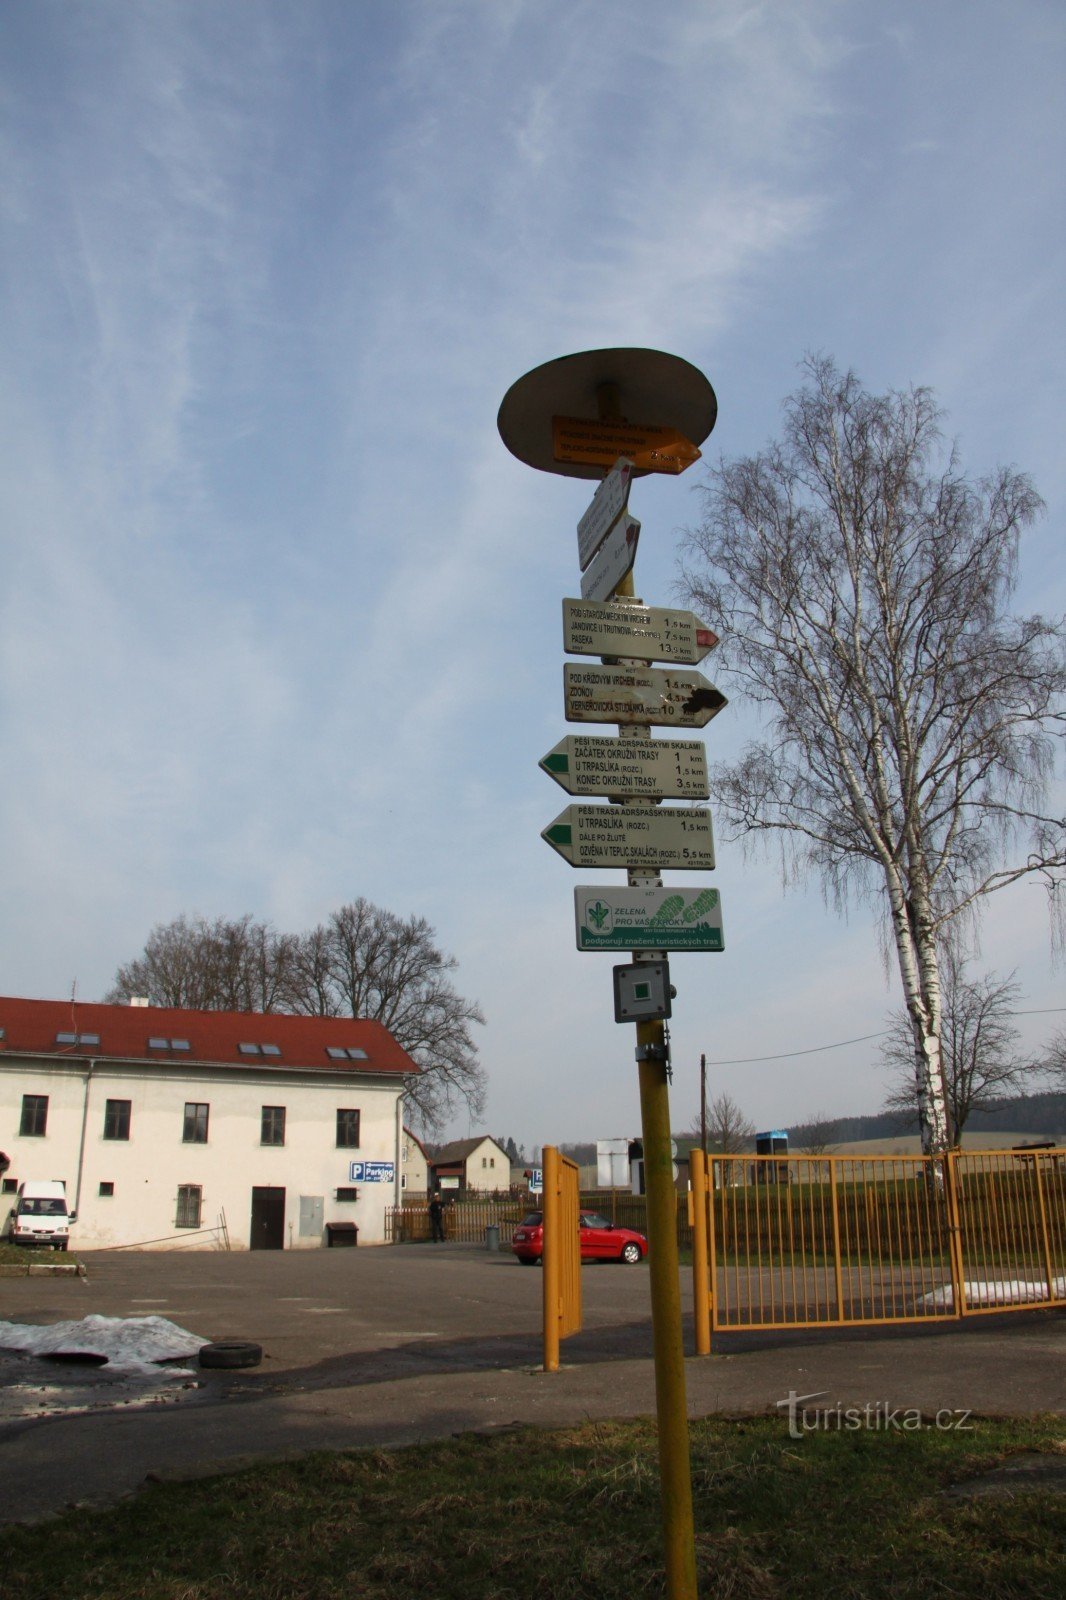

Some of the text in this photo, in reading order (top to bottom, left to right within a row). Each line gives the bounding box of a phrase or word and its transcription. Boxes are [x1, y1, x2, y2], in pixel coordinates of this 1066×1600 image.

[570, 608, 582, 617] POD
[680, 622, 691, 630] km
[570, 622, 598, 632] JANOVICE
[598, 624, 602, 632] U
[603, 624, 632, 636] TRUTNOVA
[665, 630, 678, 640] 7,5
[680, 634, 691, 642] km
[572, 634, 593, 644] PASEKA
[679, 646, 692, 654] km
[570, 674, 582, 683] POD
[612, 676, 636, 686] VRCHEM
[614, 700, 644, 715] STUDÁNKA
[591, 739, 614, 747] TRASA
[618, 740, 670, 749] ADRŠPAŠSKÝMI
[671, 742, 700, 750] SKALAMI
[574, 748, 606, 758] ZAČÁTEK
[607, 748, 636, 760] OKRUŽNÍ
[637, 750, 659, 760] TRASY
[675, 752, 680, 762] 1
[576, 762, 580, 770] U
[582, 760, 620, 772] TRPASLÍKA
[676, 766, 690, 775] 1,5
[692, 768, 704, 776] km
[576, 774, 704, 790] KONEC OKRUŽNÍ TRASY 3,5 km
[596, 808, 620, 816] TRASA
[620, 808, 675, 818] ADRŠPAŠSKÝMI
[676, 810, 707, 818] SKALAMI
[578, 817, 708, 832] U TRPASLÍKA (ROZC.) 1,5 km
[596, 834, 606, 842] PO
[604, 848, 608, 856] V
[682, 848, 697, 858] 5,5
[353, 1164, 362, 1178] P
[366, 1168, 394, 1178] Parking
